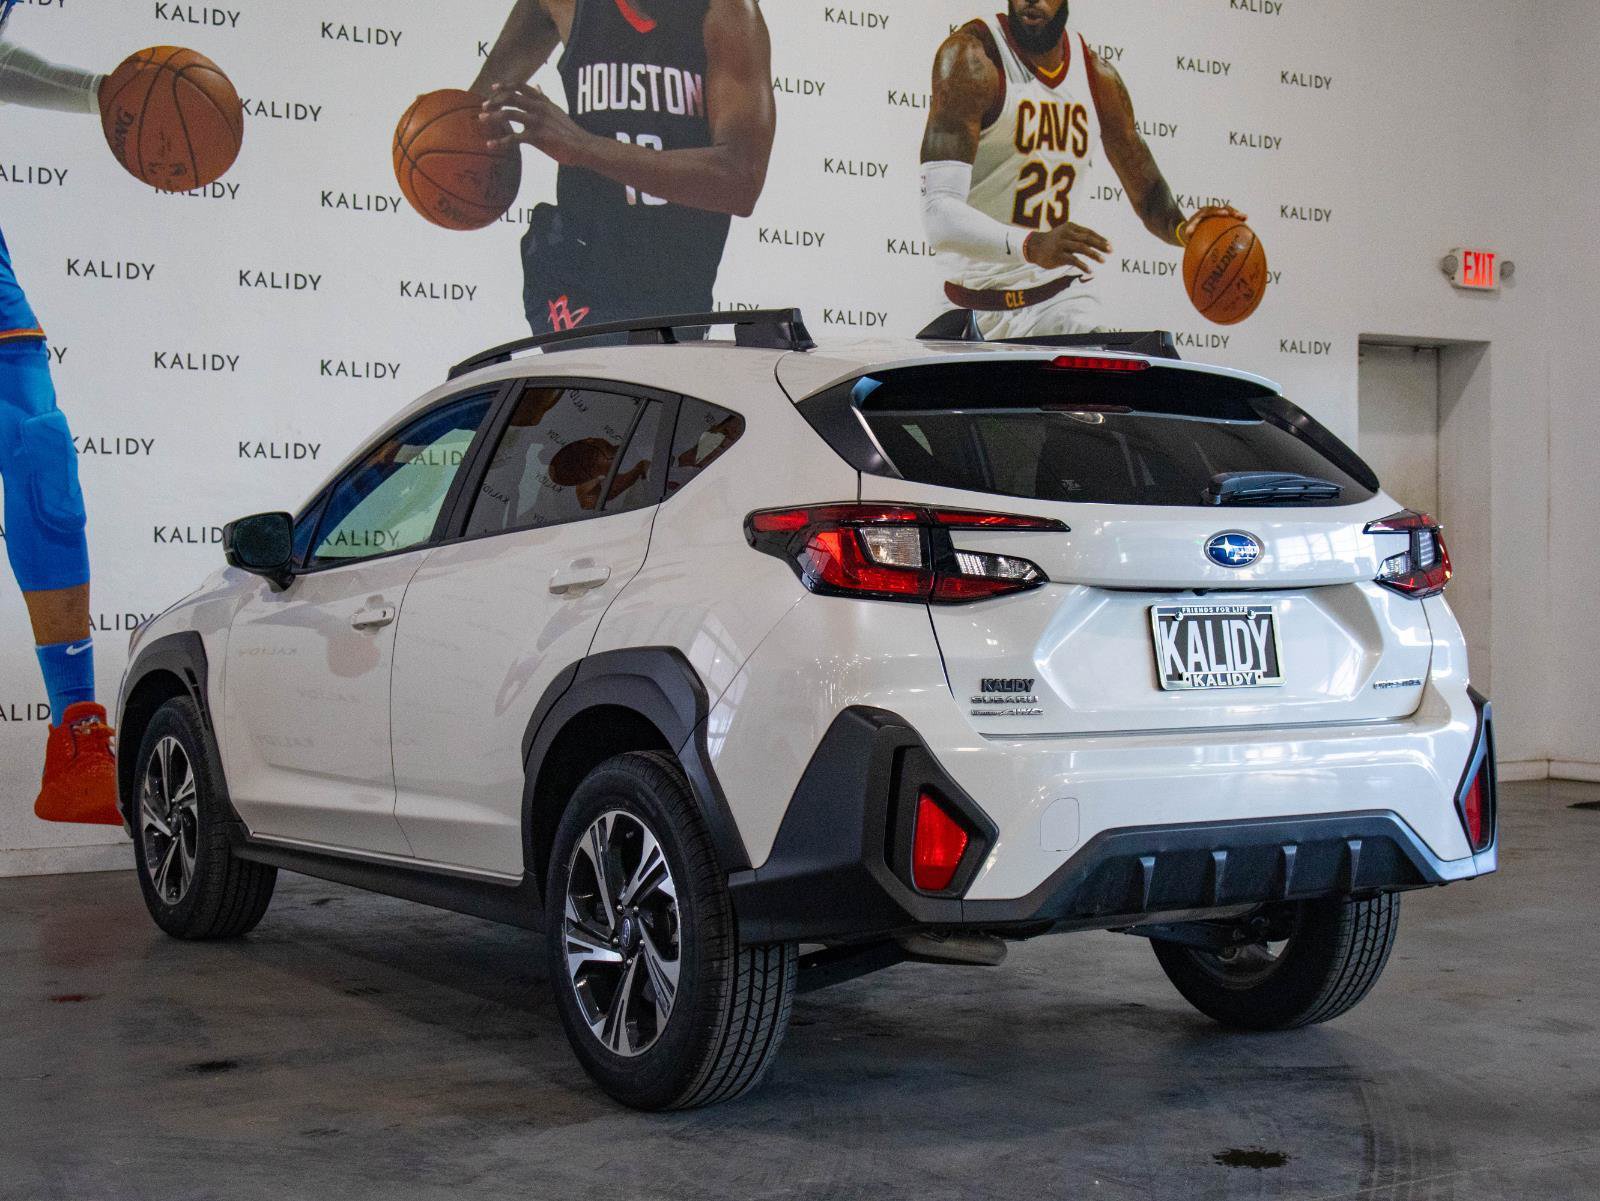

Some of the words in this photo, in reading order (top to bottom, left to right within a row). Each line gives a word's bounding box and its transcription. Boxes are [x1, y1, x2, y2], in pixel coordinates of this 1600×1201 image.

[155, 2, 241, 28] KALIDY
[1230, 0, 1283, 16] KALIDY
[825, 7, 889, 30] KALIDY
[321, 21, 402, 47] KALIDY
[1176, 56, 1231, 77] KALIDY
[577, 62, 704, 117] HOUSTON
[773, 77, 826, 97] ALIDY
[1281, 71, 1332, 90] KALIDY
[888, 90, 932, 109] KALI
[1014, 99, 1089, 160] CAVS
[1135, 120, 1178, 138] ALIDY
[1229, 131, 1282, 151] KALIDY
[0, 164, 68, 186] ALIDY
[824, 158, 888, 179] KALIDY
[321, 190, 402, 214] KALIDY
[1011, 159, 1076, 231] 23
[1280, 204, 1332, 223] KALIDY
[758, 227, 826, 248] KALIDY
[66, 258, 155, 281] KALIDY
[1122, 258, 1177, 276] KALIDY
[1463, 250, 1497, 288] EXIT
[239, 269, 322, 291] KALIDY
[400, 280, 477, 301] KALIDY
[1005, 289, 1025, 309] CLE
[823, 308, 888, 327] KALIDY
[1175, 331, 1230, 350] KALIDY
[1280, 338, 1332, 356] KALIDY
[154, 351, 240, 372] KALIDY
[320, 359, 401, 379] KALIDY
[239, 440, 322, 460] KALIDY
[154, 525, 223, 544] KALID
[1160, 619, 1269, 675] KALIDY
[980, 678, 1035, 692] KALIDY
[1193, 672, 1253, 687] KALIDY
[971, 696, 1039, 704] SUBARU
